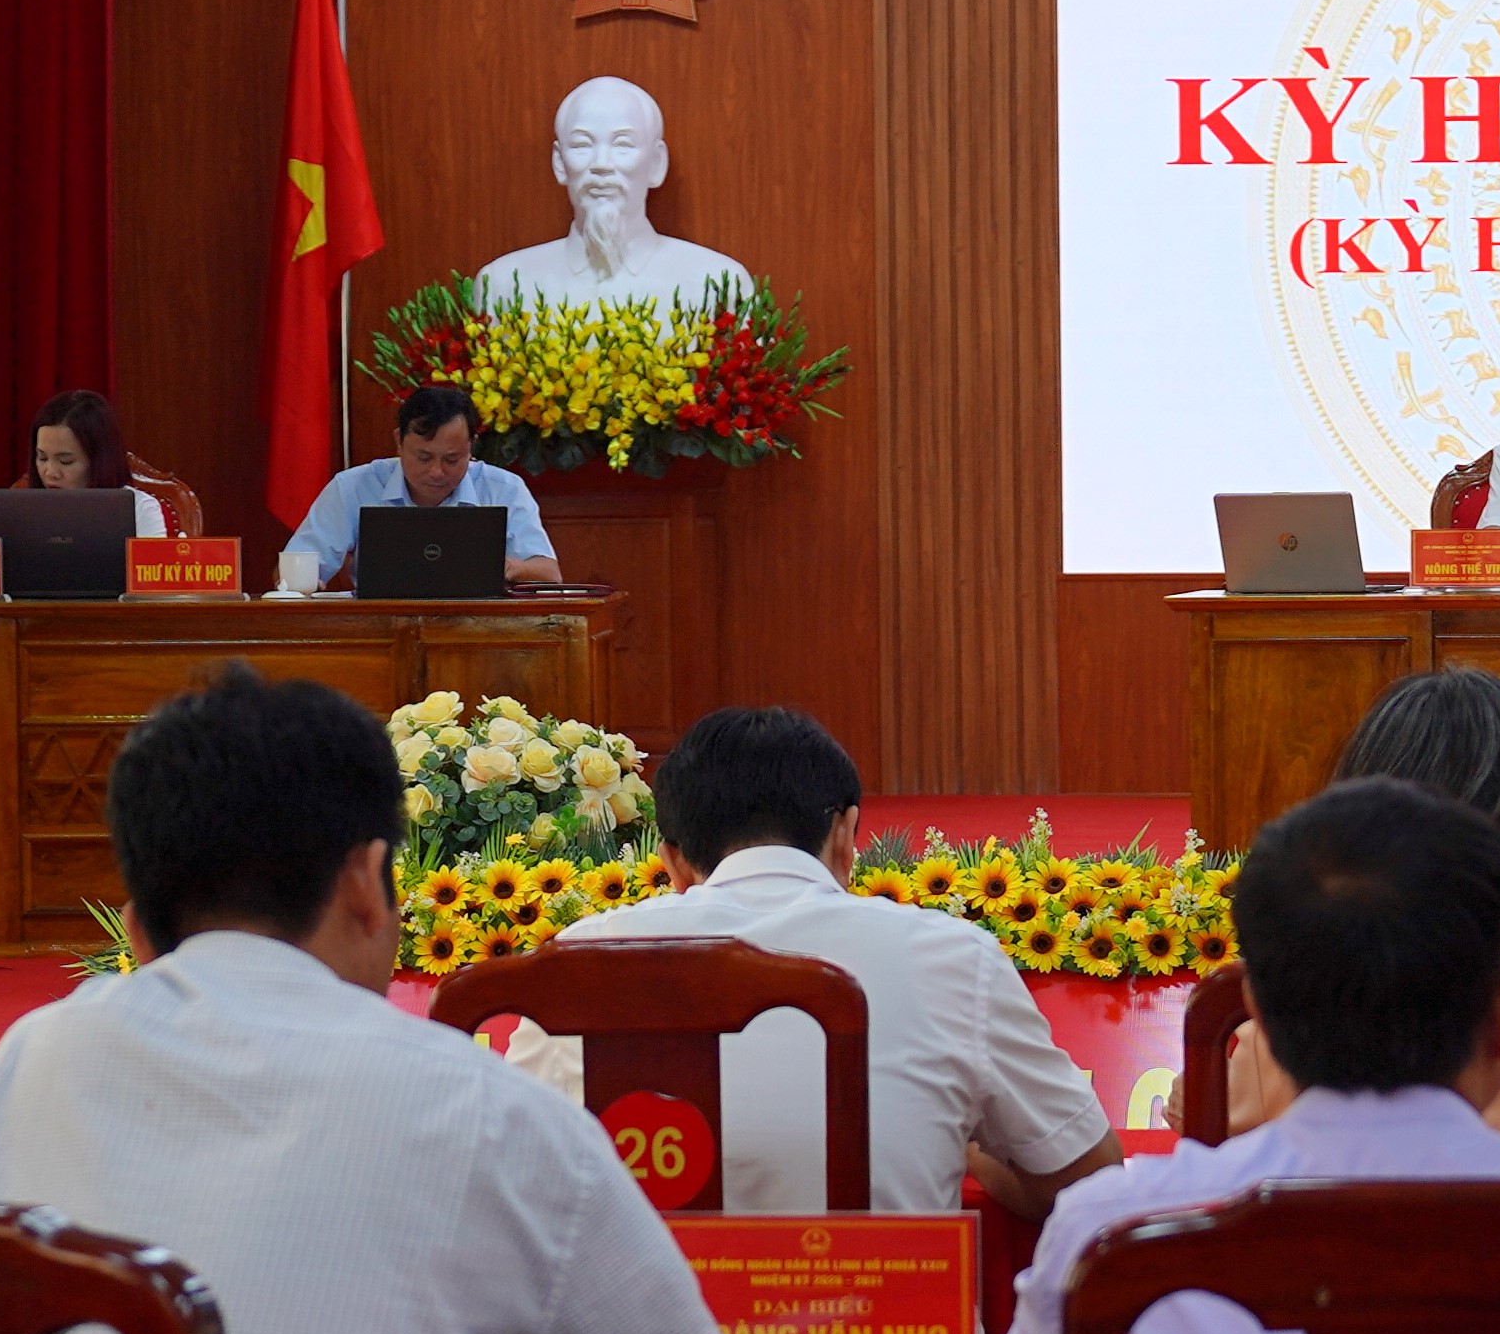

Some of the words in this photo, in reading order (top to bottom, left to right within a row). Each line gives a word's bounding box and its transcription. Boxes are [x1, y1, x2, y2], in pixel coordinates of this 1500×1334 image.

[1167, 47, 1372, 165] KỲ
[1291, 200, 1443, 288] (KỲ
[135, 563, 163, 581] THƯ
[165, 561, 181, 581] KÝ
[185, 561, 202, 581] KỲ
[206, 565, 232, 585] HỌP
[1425, 562, 1457, 574] NÔNG
[615, 1126, 686, 1179] 26
